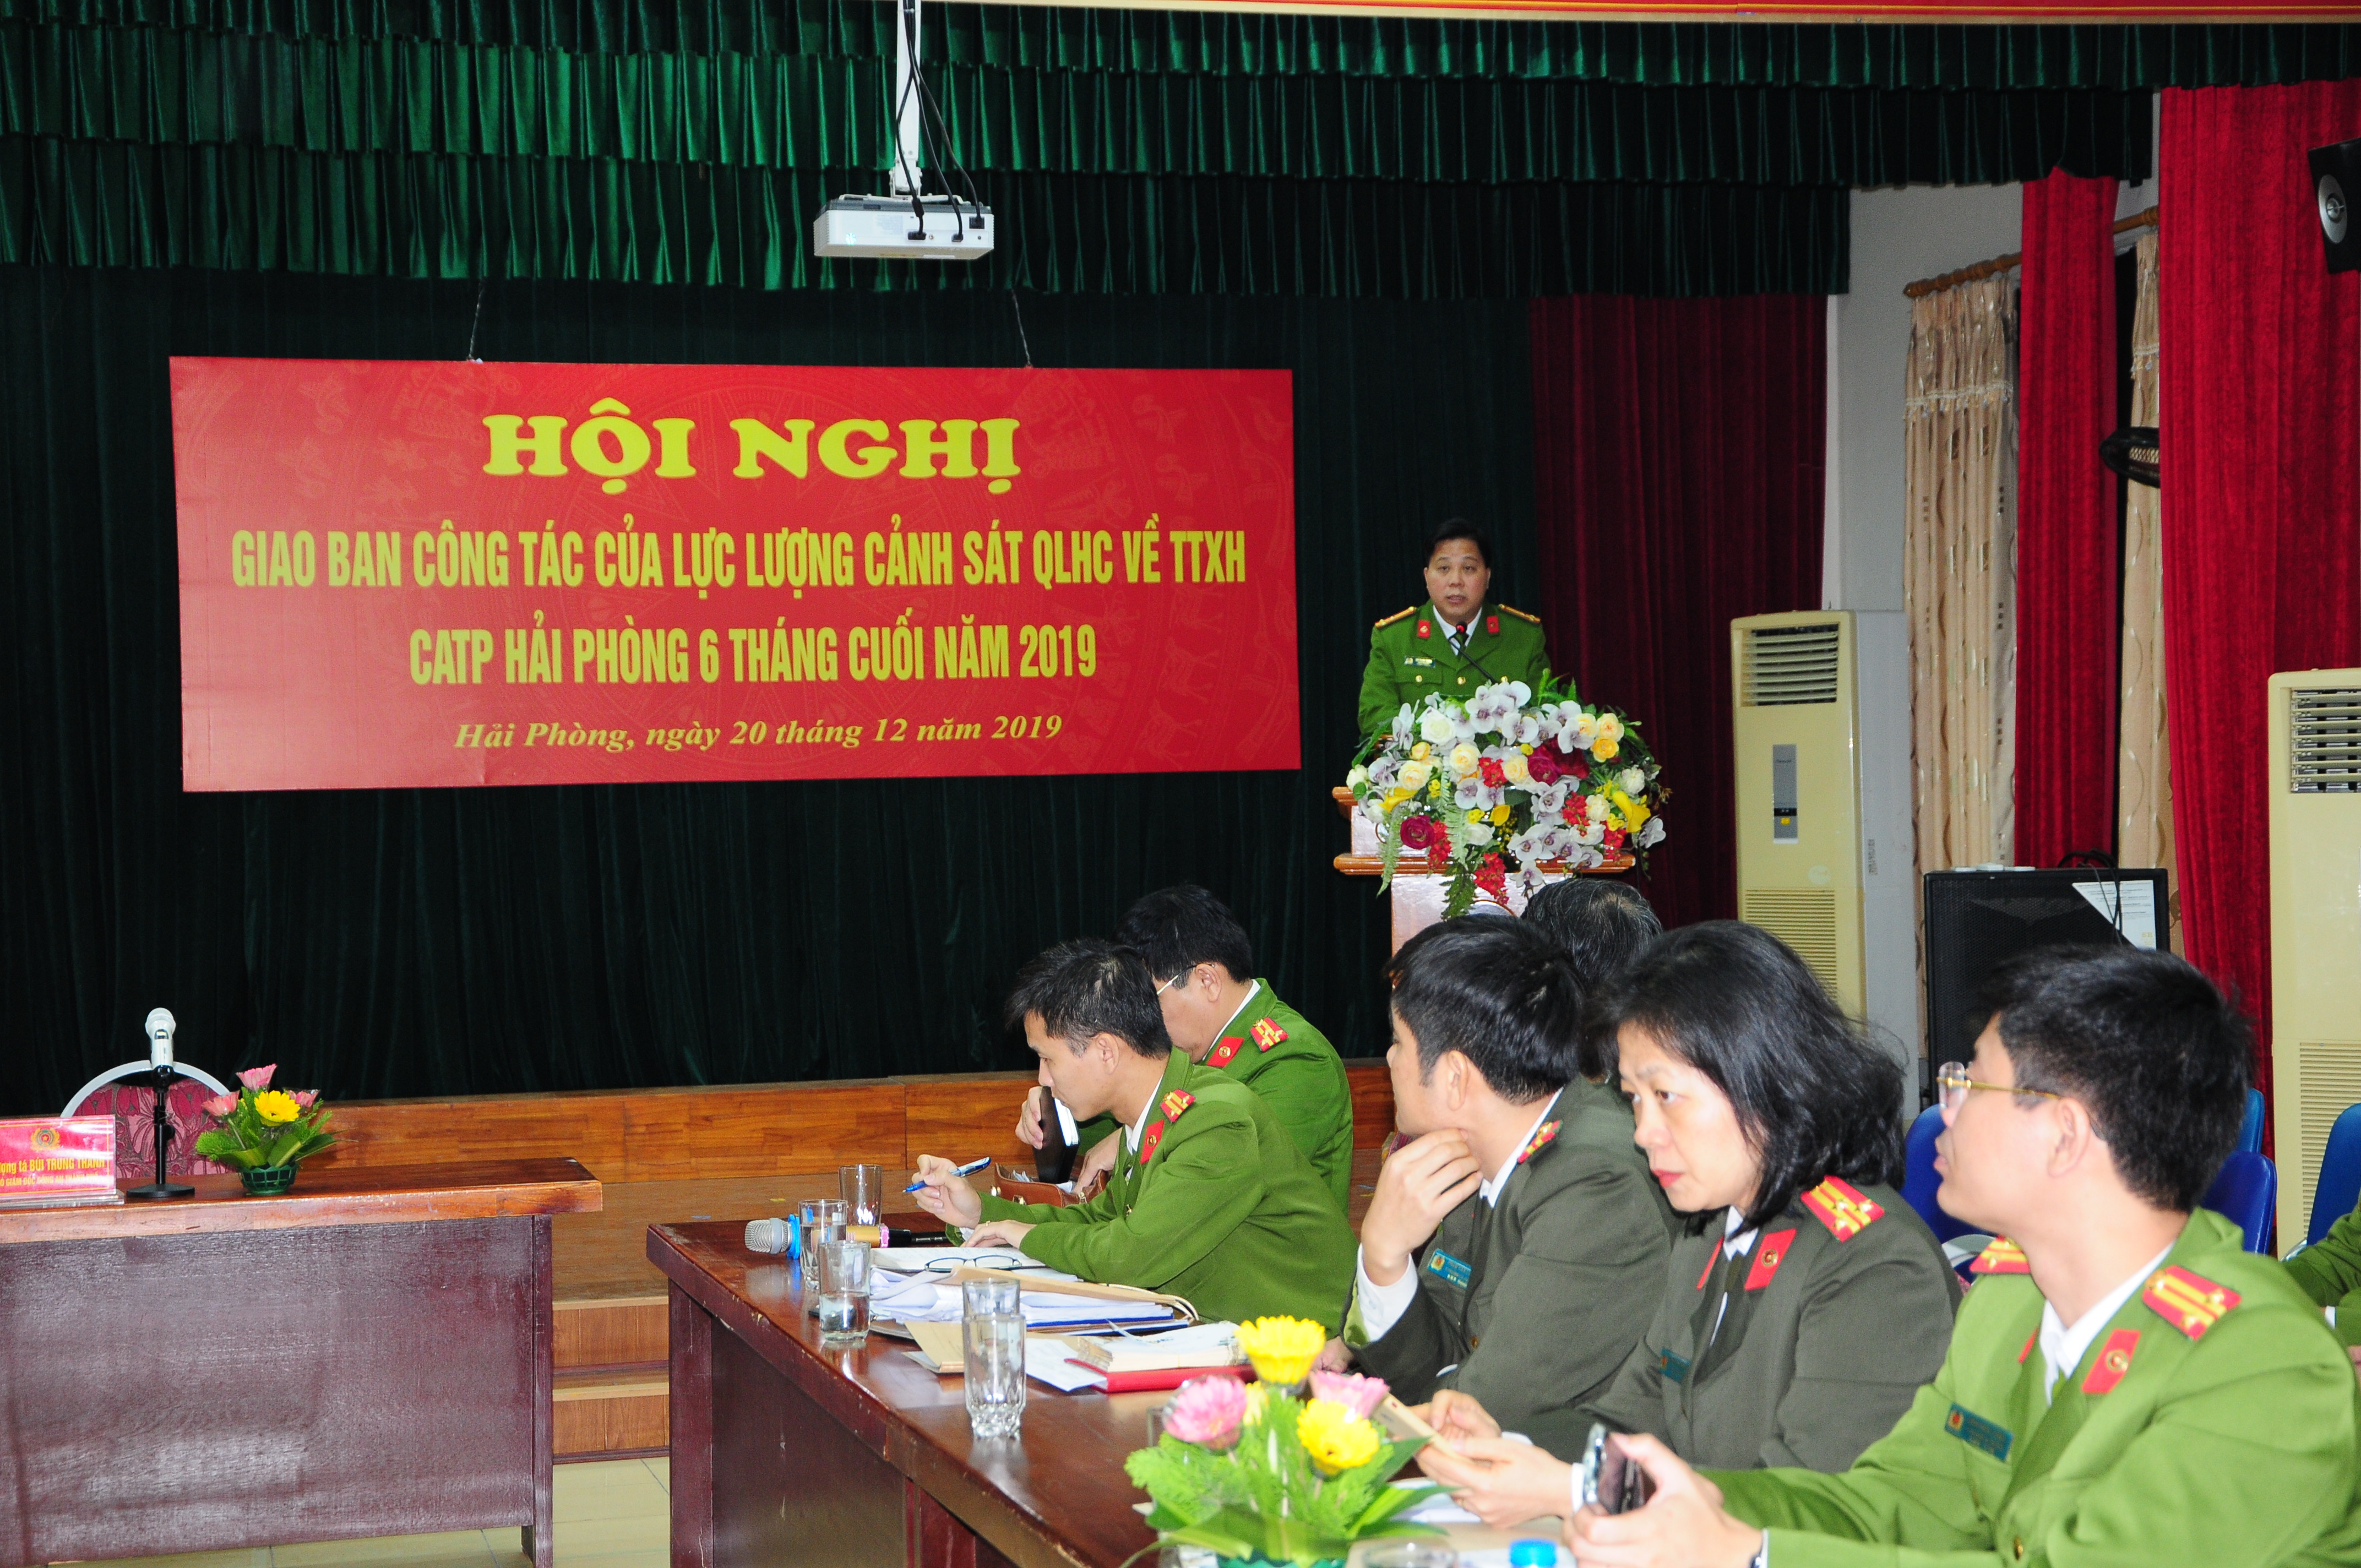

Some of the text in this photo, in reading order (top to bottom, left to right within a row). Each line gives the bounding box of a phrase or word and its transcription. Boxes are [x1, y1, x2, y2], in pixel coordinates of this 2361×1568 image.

[481, 396, 1022, 496] HỘI NGHỊ
[231, 512, 1247, 600] GIAO BAN CÔNG TÁC CỦA LỰC LƯỢNG CẢNH SÁT QLHC VỀ TTXH
[409, 606, 1098, 685] CATP HẢI PHÒNG 6 THÁNG CUỐI NĂM 2019
[454, 714, 1063, 753] Hải Phòng, ngày 20 tháng 12 năm 2019
[46, 1158, 75, 1171] TRUNG
